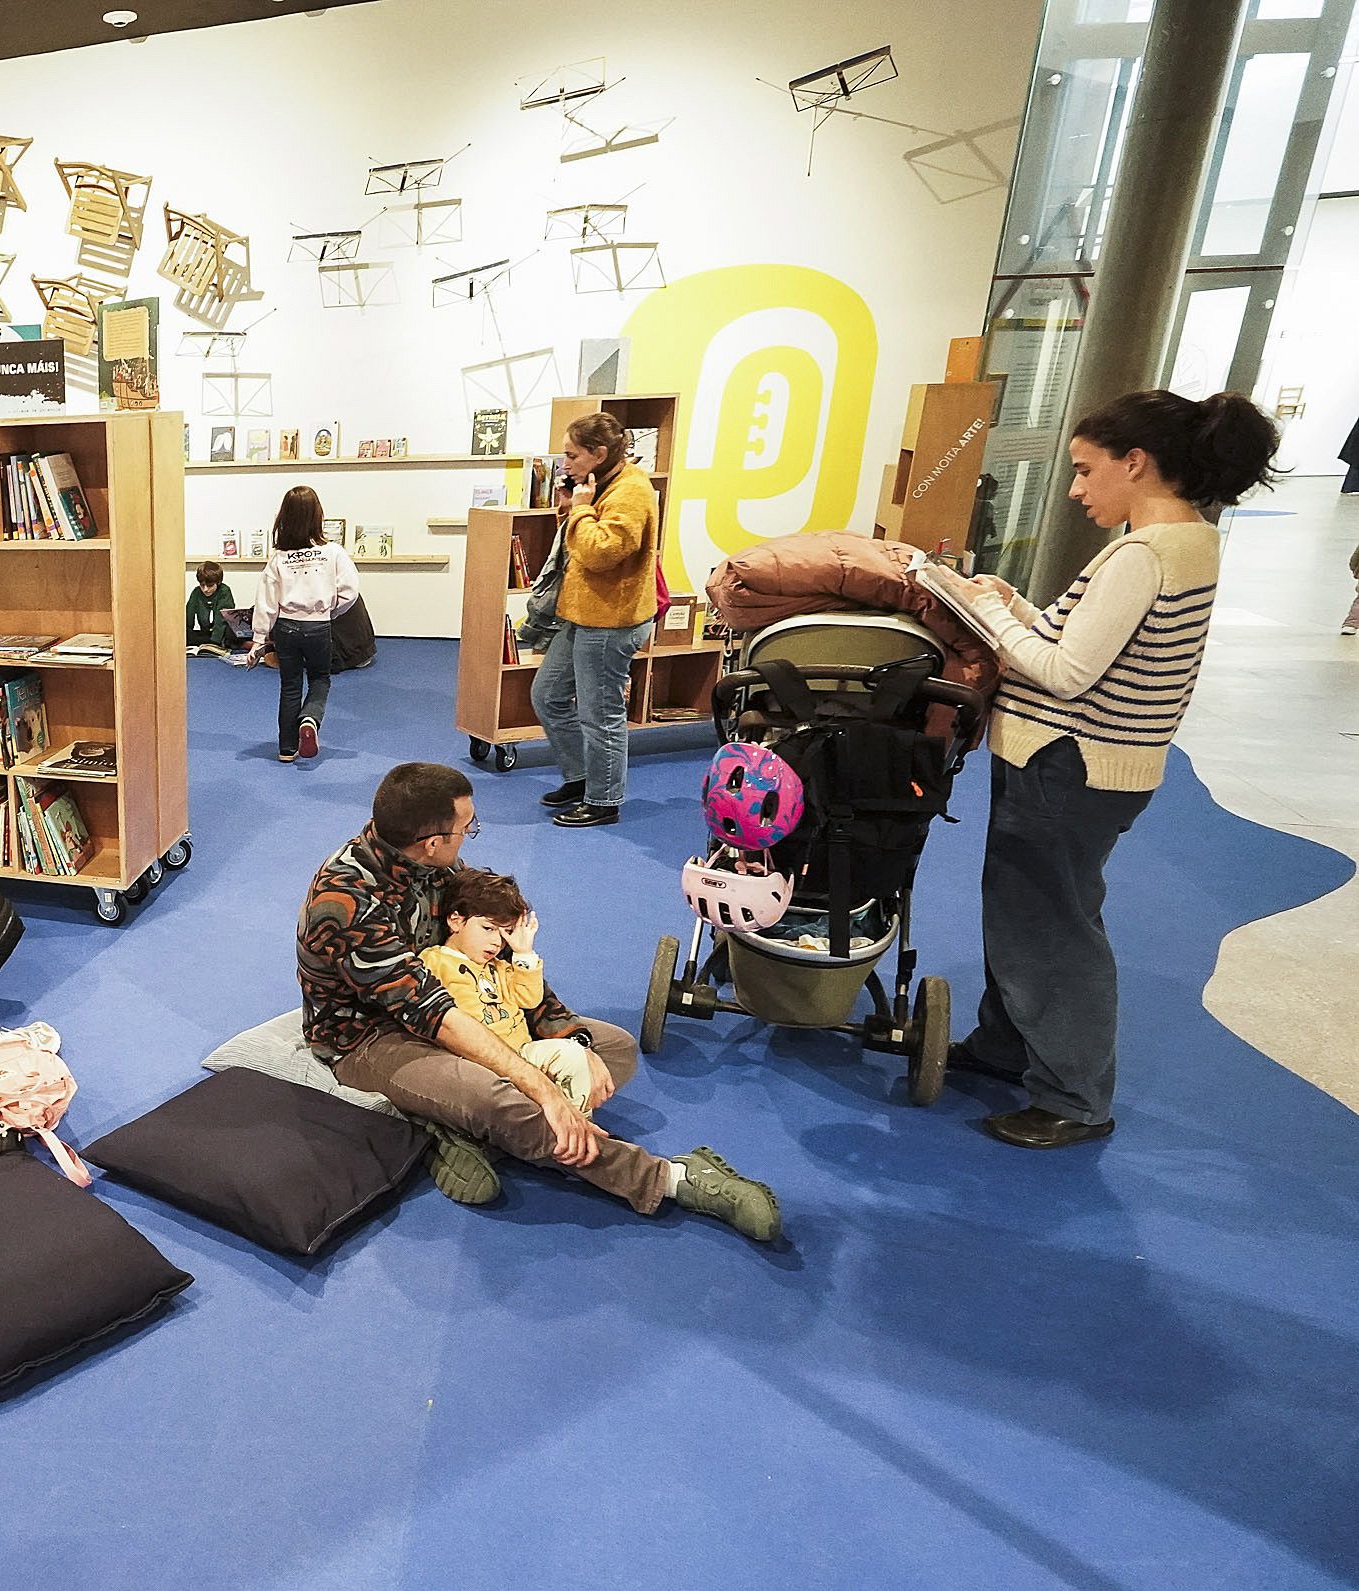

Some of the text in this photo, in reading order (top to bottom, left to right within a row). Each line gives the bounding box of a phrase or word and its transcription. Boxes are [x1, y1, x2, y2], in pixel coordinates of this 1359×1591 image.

[27, 360, 59, 374] MÁIS!
[912, 418, 986, 499] CON MOITA ARTE!
